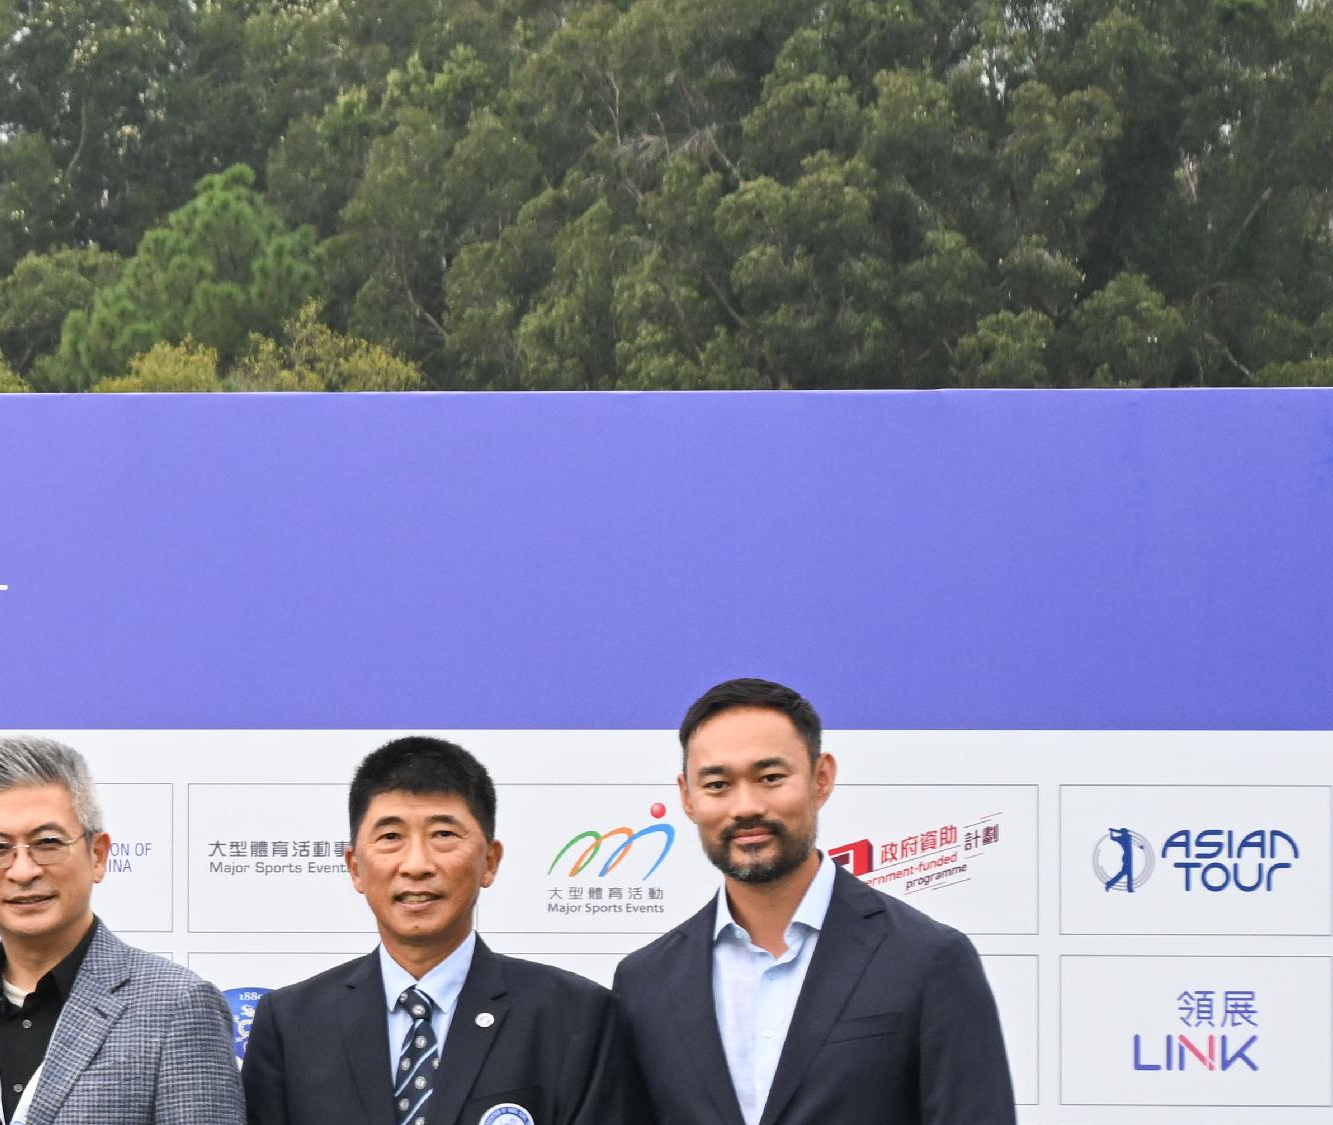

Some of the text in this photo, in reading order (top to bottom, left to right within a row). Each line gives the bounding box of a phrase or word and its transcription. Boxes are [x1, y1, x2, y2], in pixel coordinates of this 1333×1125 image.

[135, 842, 152, 857] OF
[208, 841, 345, 859] 大型體育活動事
[880, 825, 957, 864] 政府資助
[1161, 830, 1300, 859] ASIAN
[108, 859, 133, 873] INA
[210, 862, 250, 875] Major
[256, 862, 302, 876] Sports
[868, 852, 957, 886] ernment-funded
[905, 864, 967, 891] programme
[1173, 862, 1292, 892] TOUR
[549, 887, 663, 900] 大型體育活動
[548, 903, 664, 915] Major Sports Events
[1177, 991, 1258, 1027] 領展
[1134, 1034, 1259, 1071] LINK
